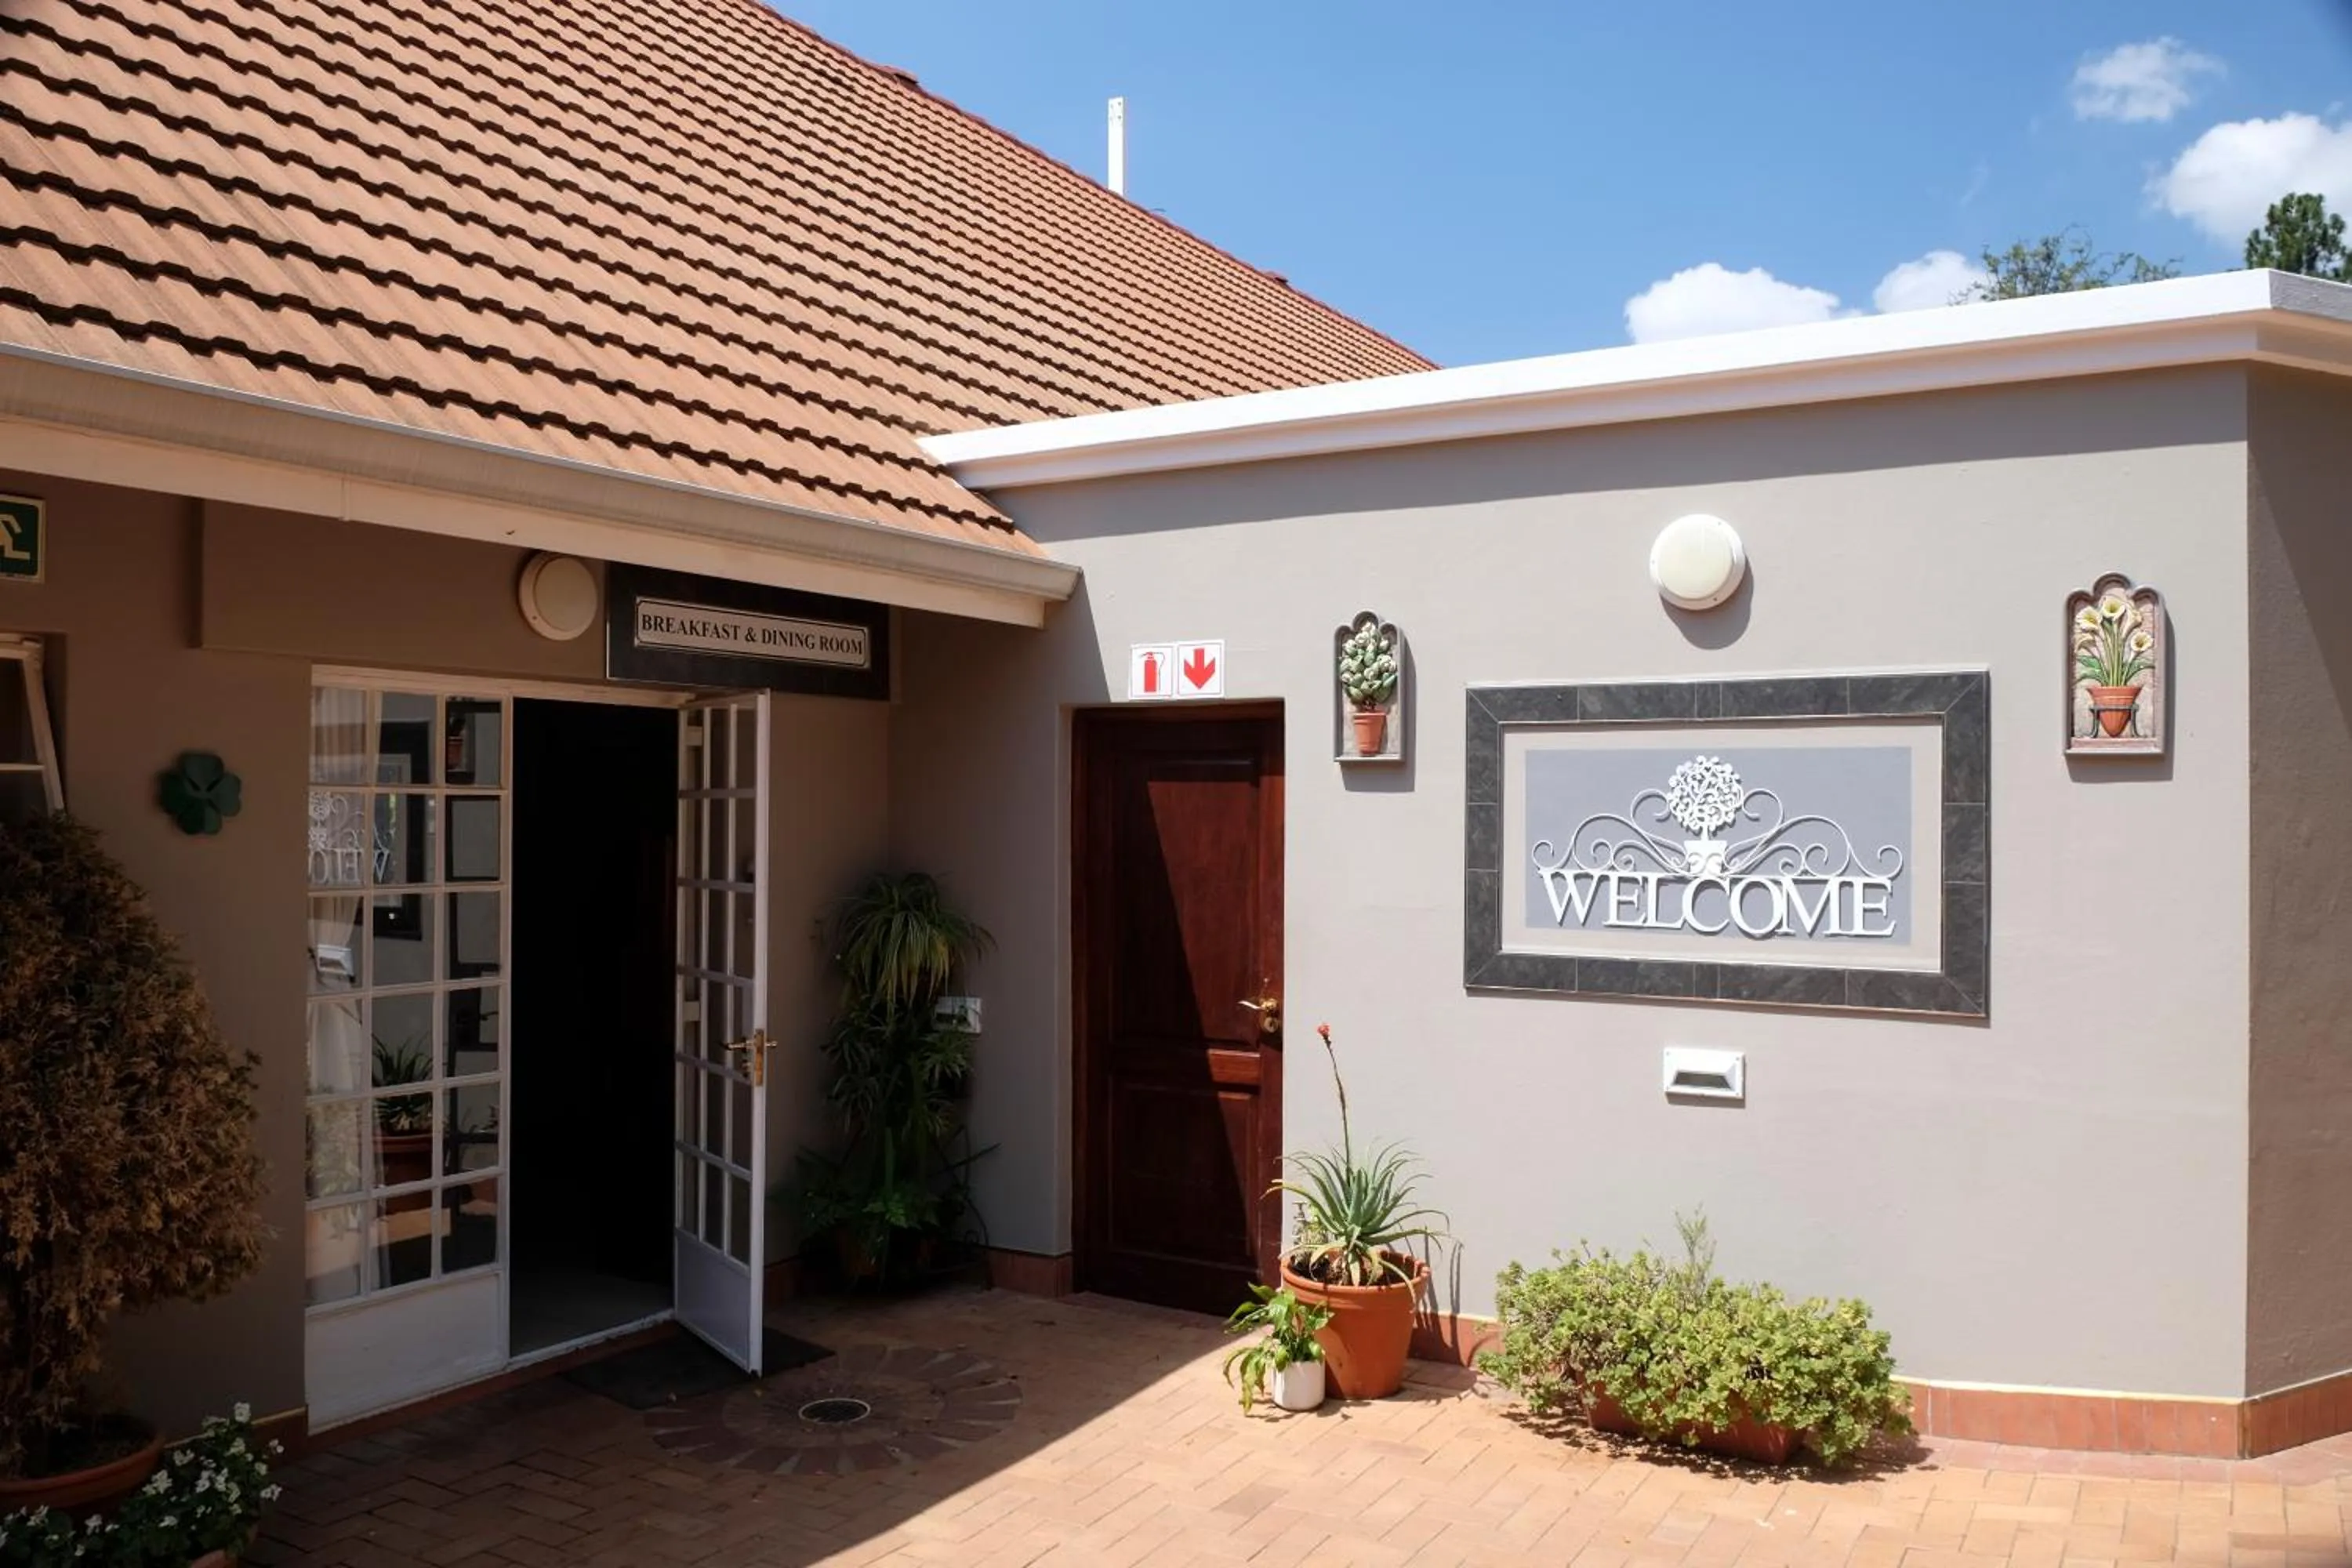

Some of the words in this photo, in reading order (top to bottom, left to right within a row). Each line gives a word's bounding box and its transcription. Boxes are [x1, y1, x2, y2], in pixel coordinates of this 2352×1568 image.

[641, 614, 740, 641] BREAKFAST
[745, 628, 757, 643] &
[761, 630, 815, 650] DINING
[819, 637, 863, 655] ROOM
[1539, 867, 1896, 937] WELCOME
